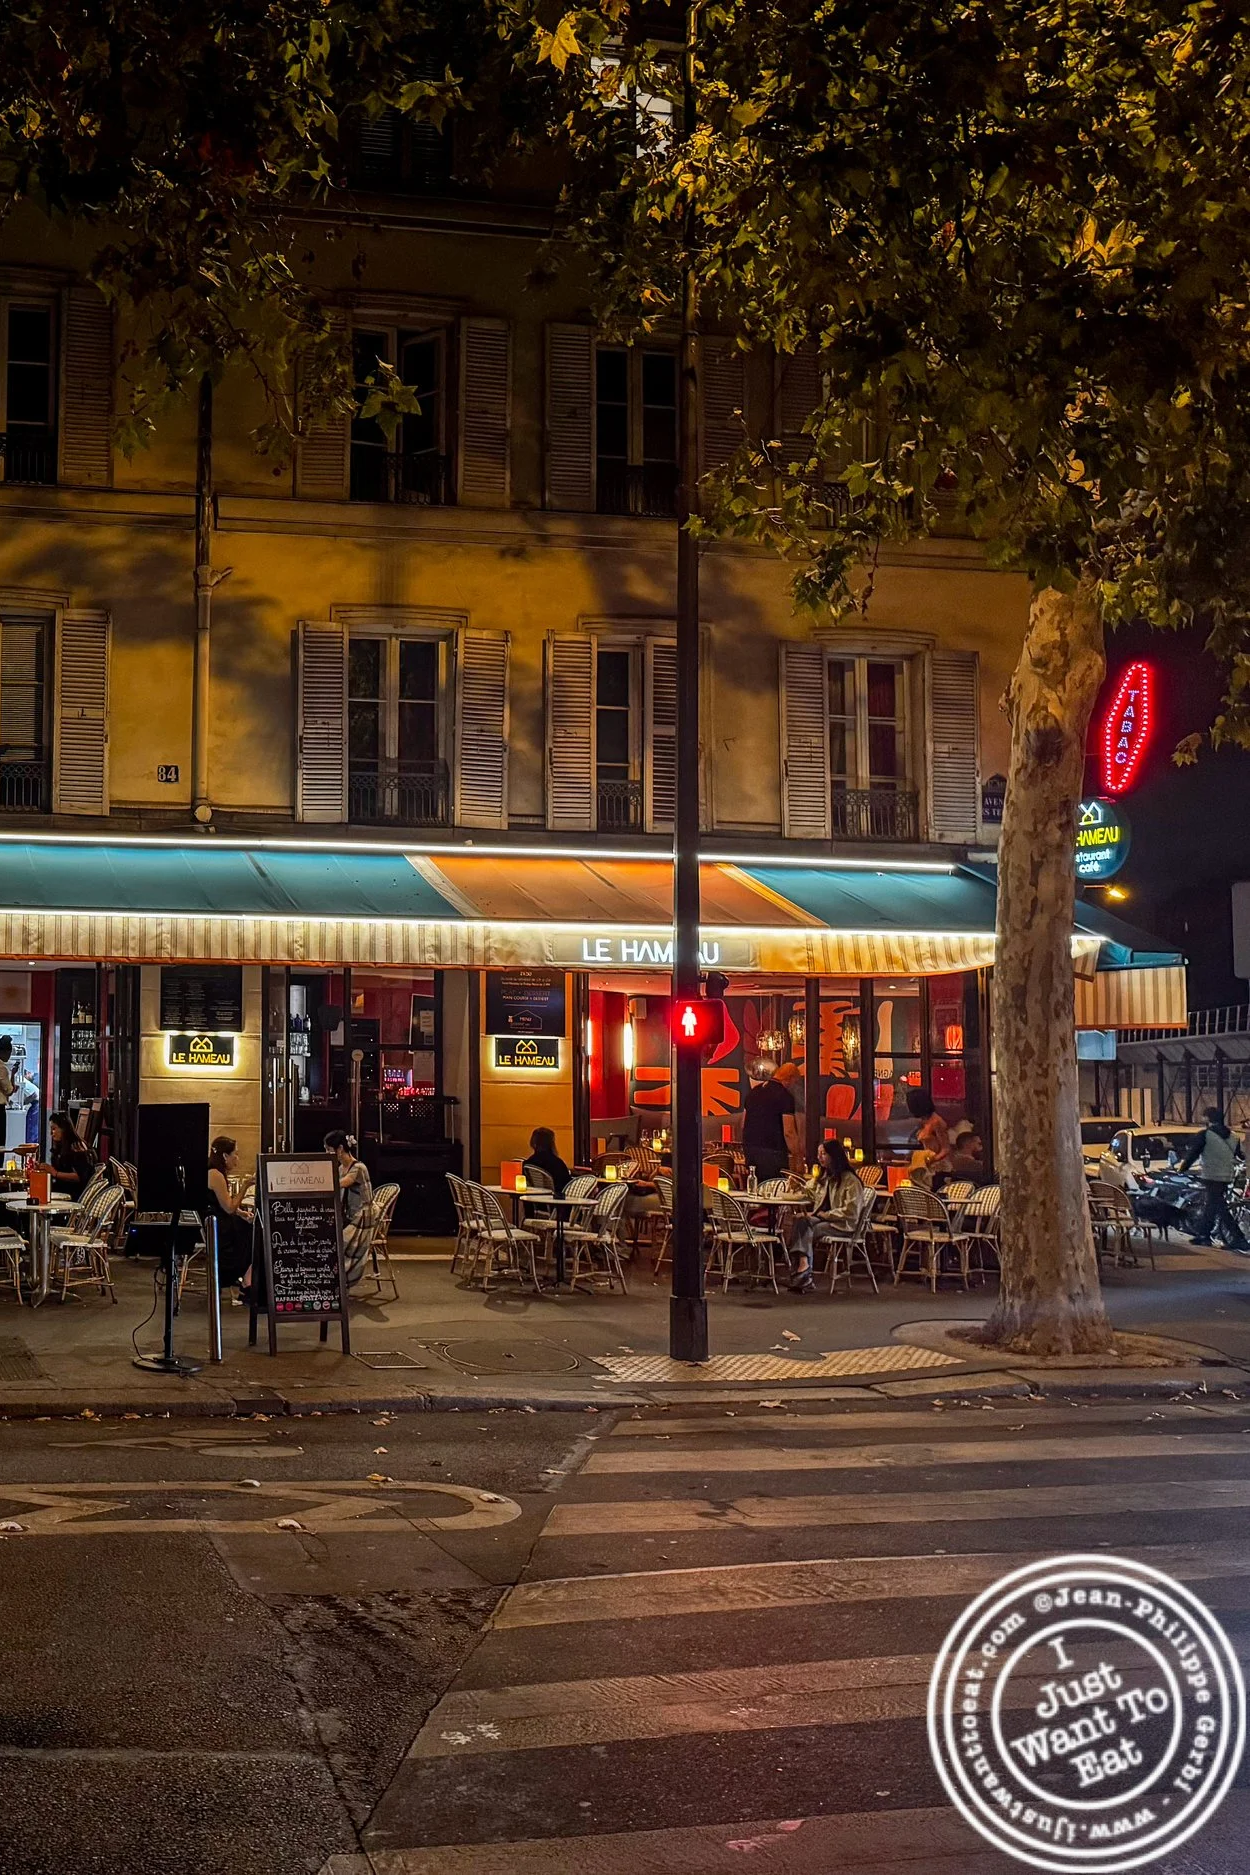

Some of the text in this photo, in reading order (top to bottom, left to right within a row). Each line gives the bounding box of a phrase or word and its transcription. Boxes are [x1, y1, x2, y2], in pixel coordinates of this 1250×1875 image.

[1115, 690, 1140, 765] TABAC
[158, 765, 177, 782] 84
[984, 796, 1003, 806] AVEN
[1075, 848, 1111, 863] staurant
[582, 937, 720, 965] LE HAMU
[172, 1052, 231, 1065] LE HAMEAU
[499, 1055, 556, 1067] LE HAMEAU
[276, 1176, 326, 1186] LE HAMEAU
